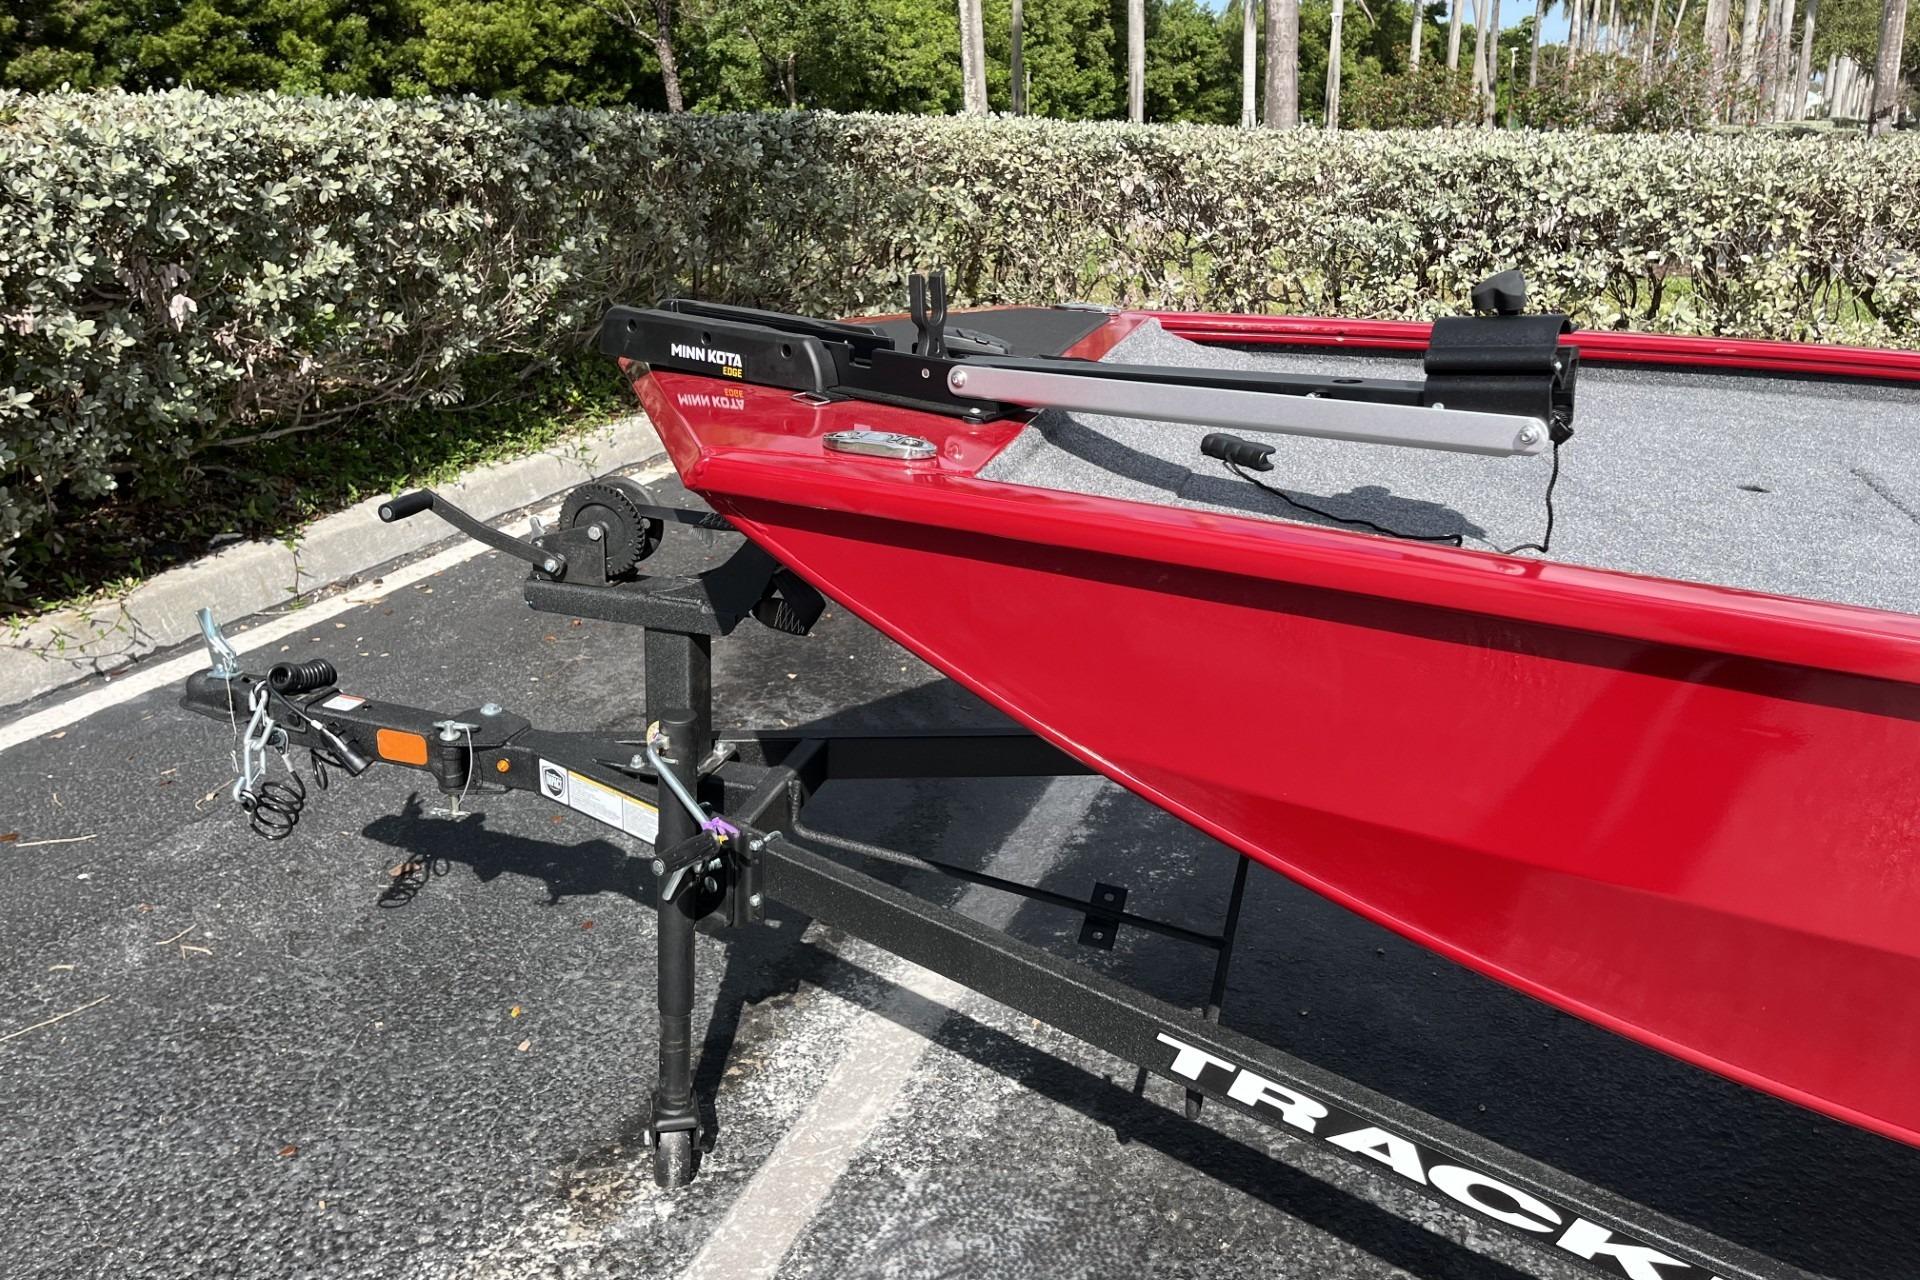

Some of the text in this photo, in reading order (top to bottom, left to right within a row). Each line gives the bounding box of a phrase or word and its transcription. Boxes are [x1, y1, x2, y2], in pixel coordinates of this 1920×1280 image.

[671, 343, 742, 367] MINN KOTA
[723, 366, 742, 378] EDGE
[1156, 1032, 1723, 1280] TRACK
